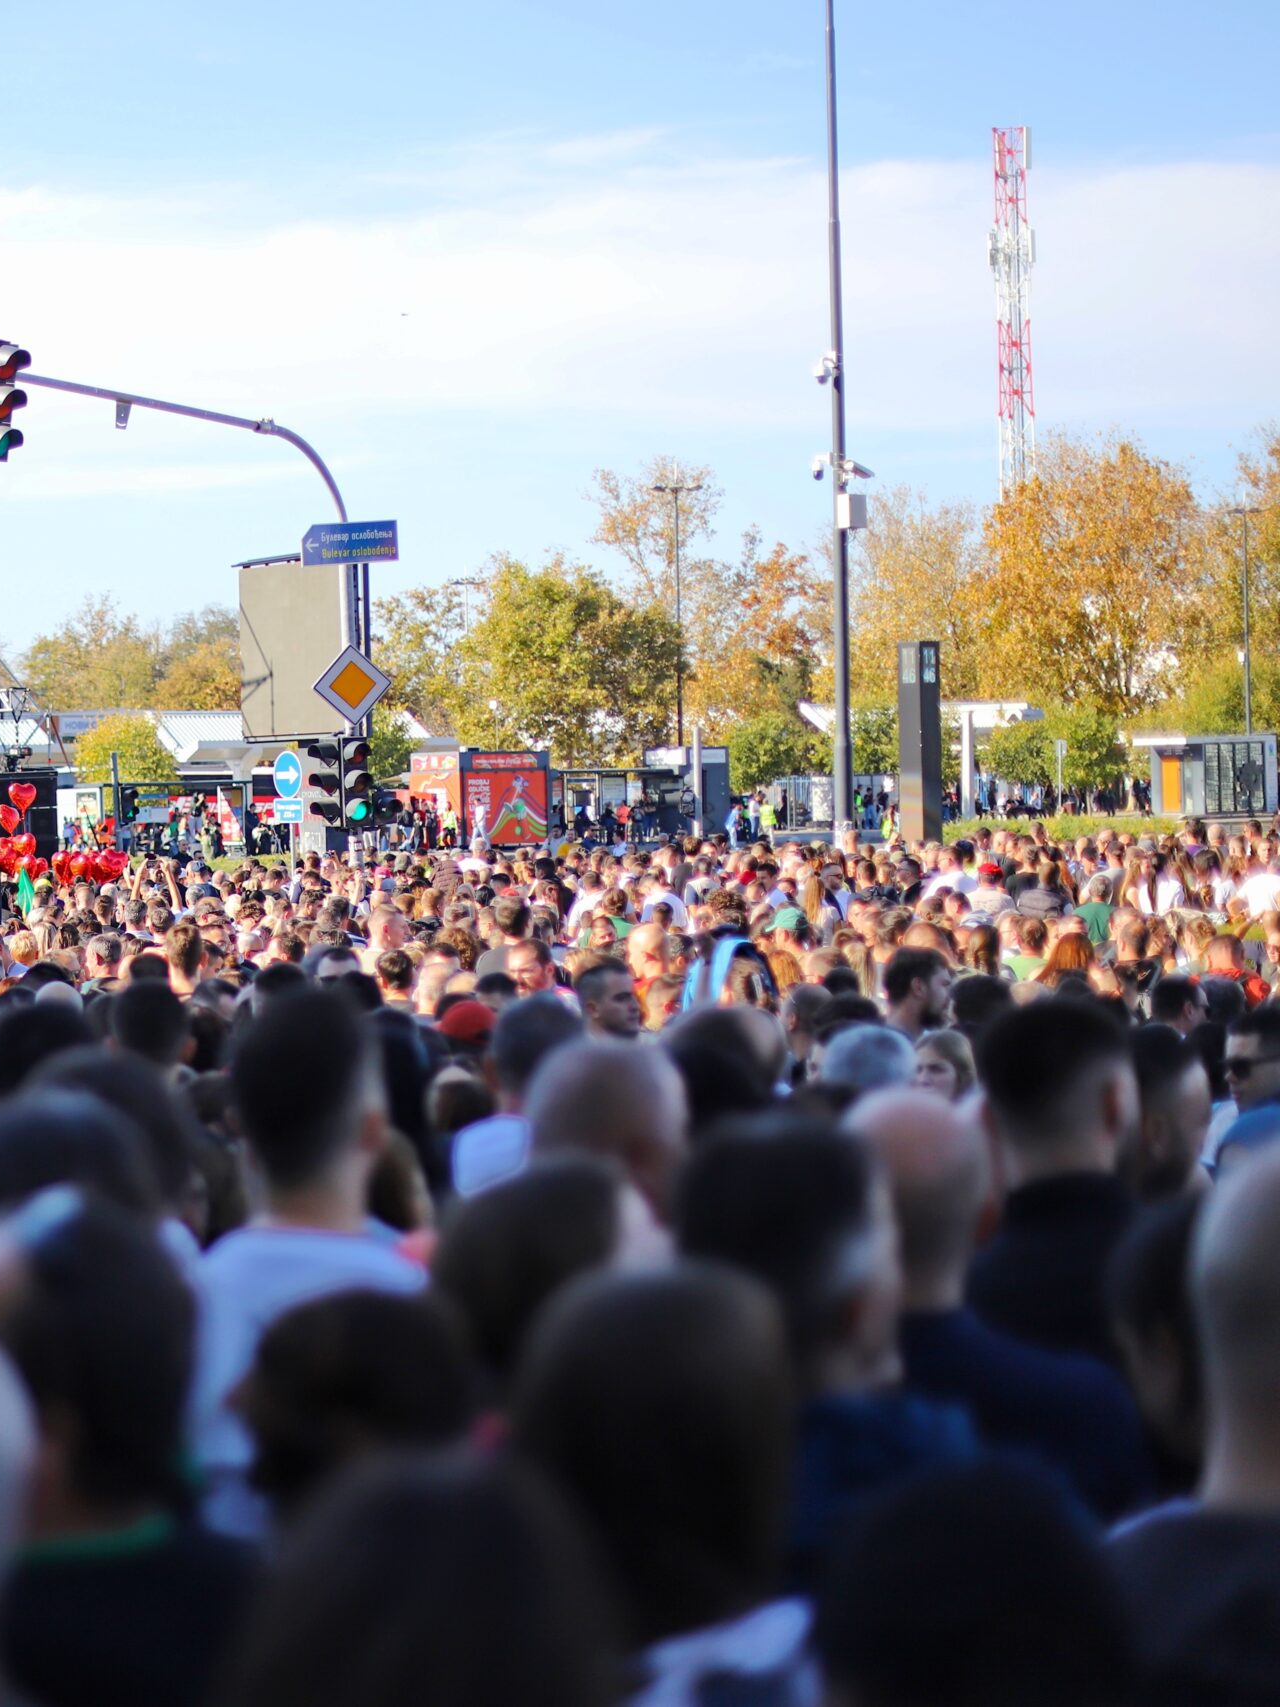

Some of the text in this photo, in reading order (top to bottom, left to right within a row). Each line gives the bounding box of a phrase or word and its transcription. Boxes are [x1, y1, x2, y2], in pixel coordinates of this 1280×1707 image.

[321, 530, 392, 543] Булевар ослобођења
[322, 546, 395, 558] Bulevar oslobođenja
[924, 650, 935, 664] 11
[924, 668, 936, 683] 46
